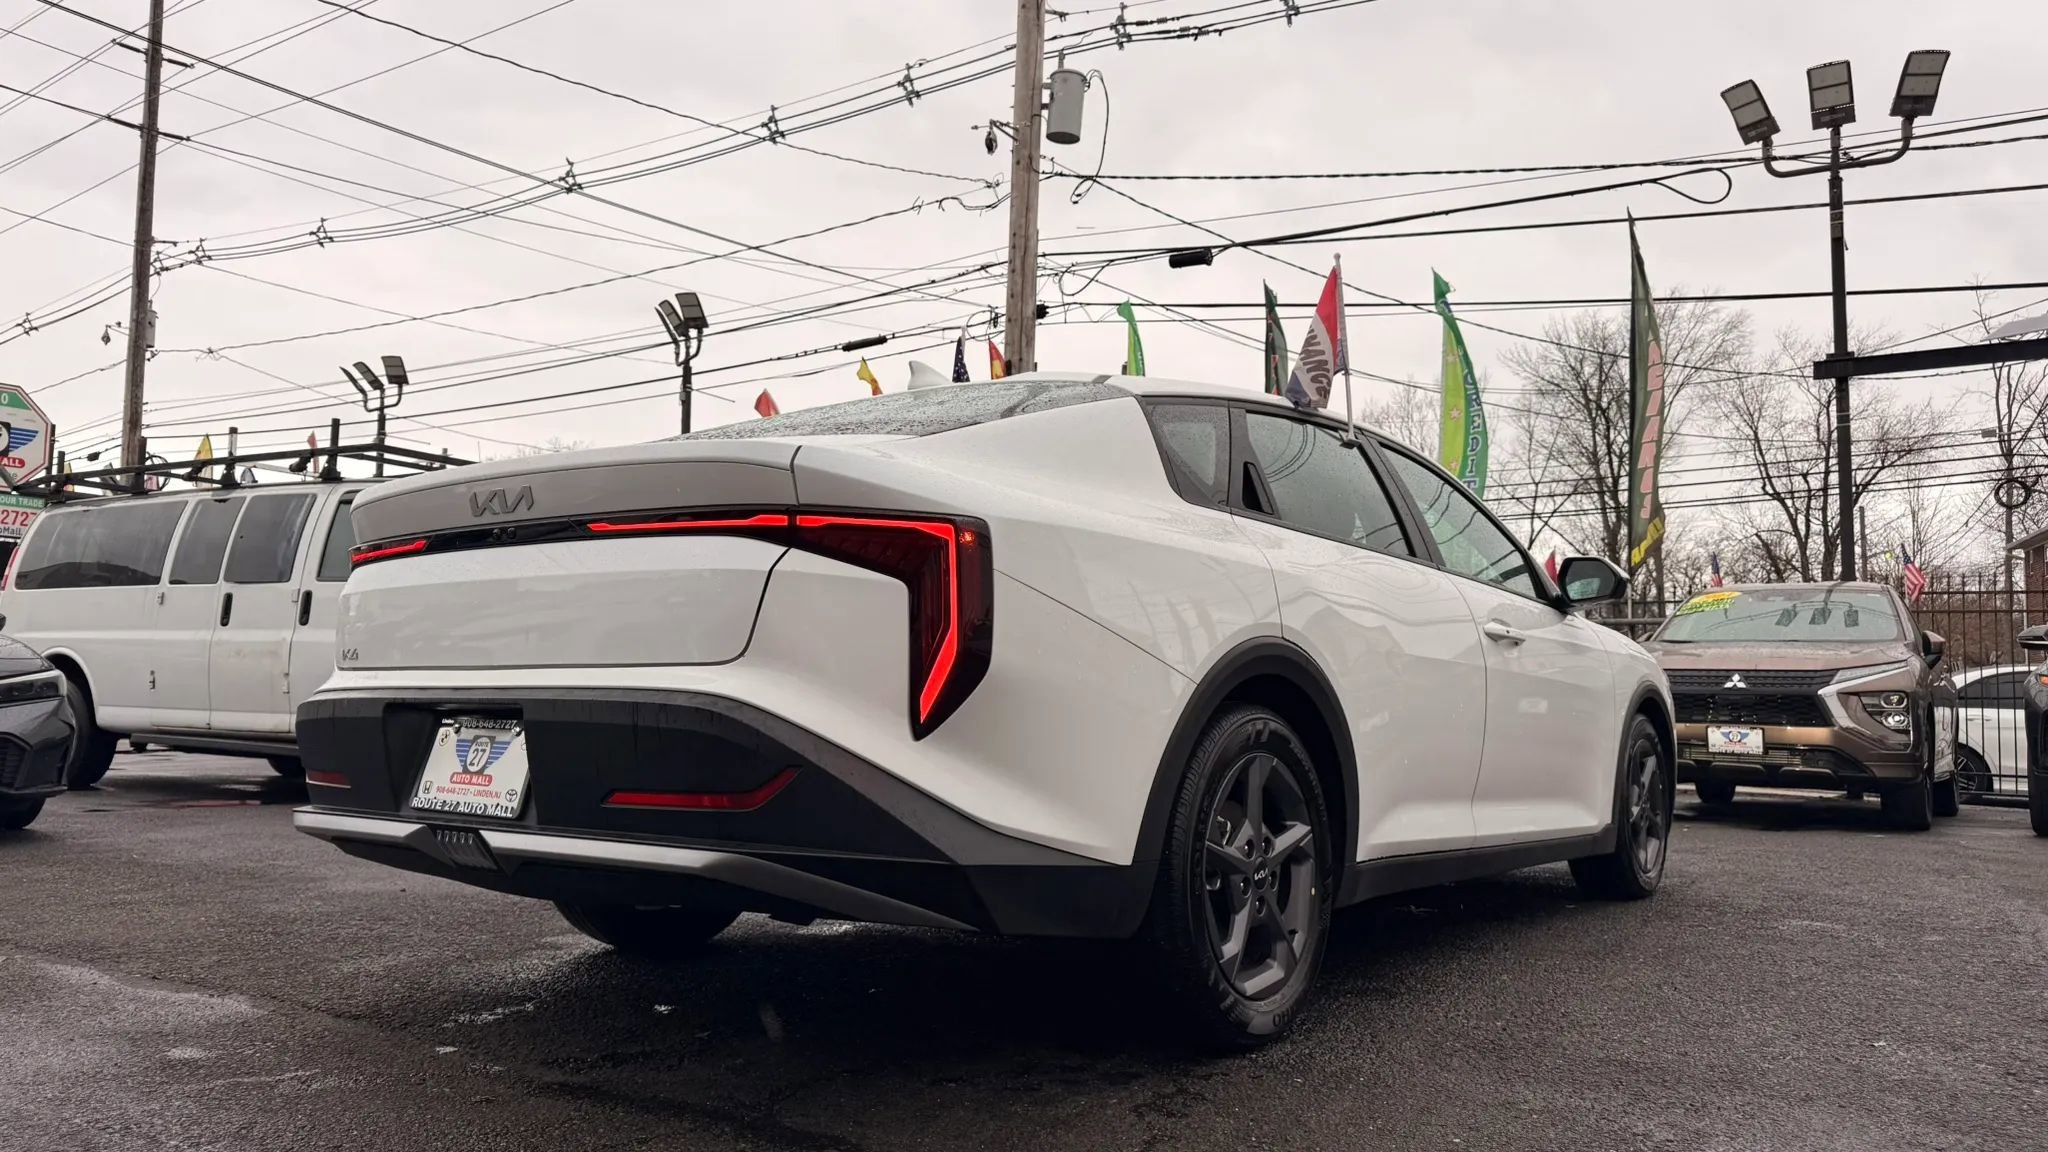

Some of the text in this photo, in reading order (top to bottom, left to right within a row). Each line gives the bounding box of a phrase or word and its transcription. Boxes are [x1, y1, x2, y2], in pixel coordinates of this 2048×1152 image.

[469, 484, 535, 517] KIA
[342, 648, 359, 661] K4
[468, 748, 487, 767] 27
[451, 774, 489, 785] AUTO MALL
[411, 797, 513, 818] ROUTE 27 AUTO MALL
